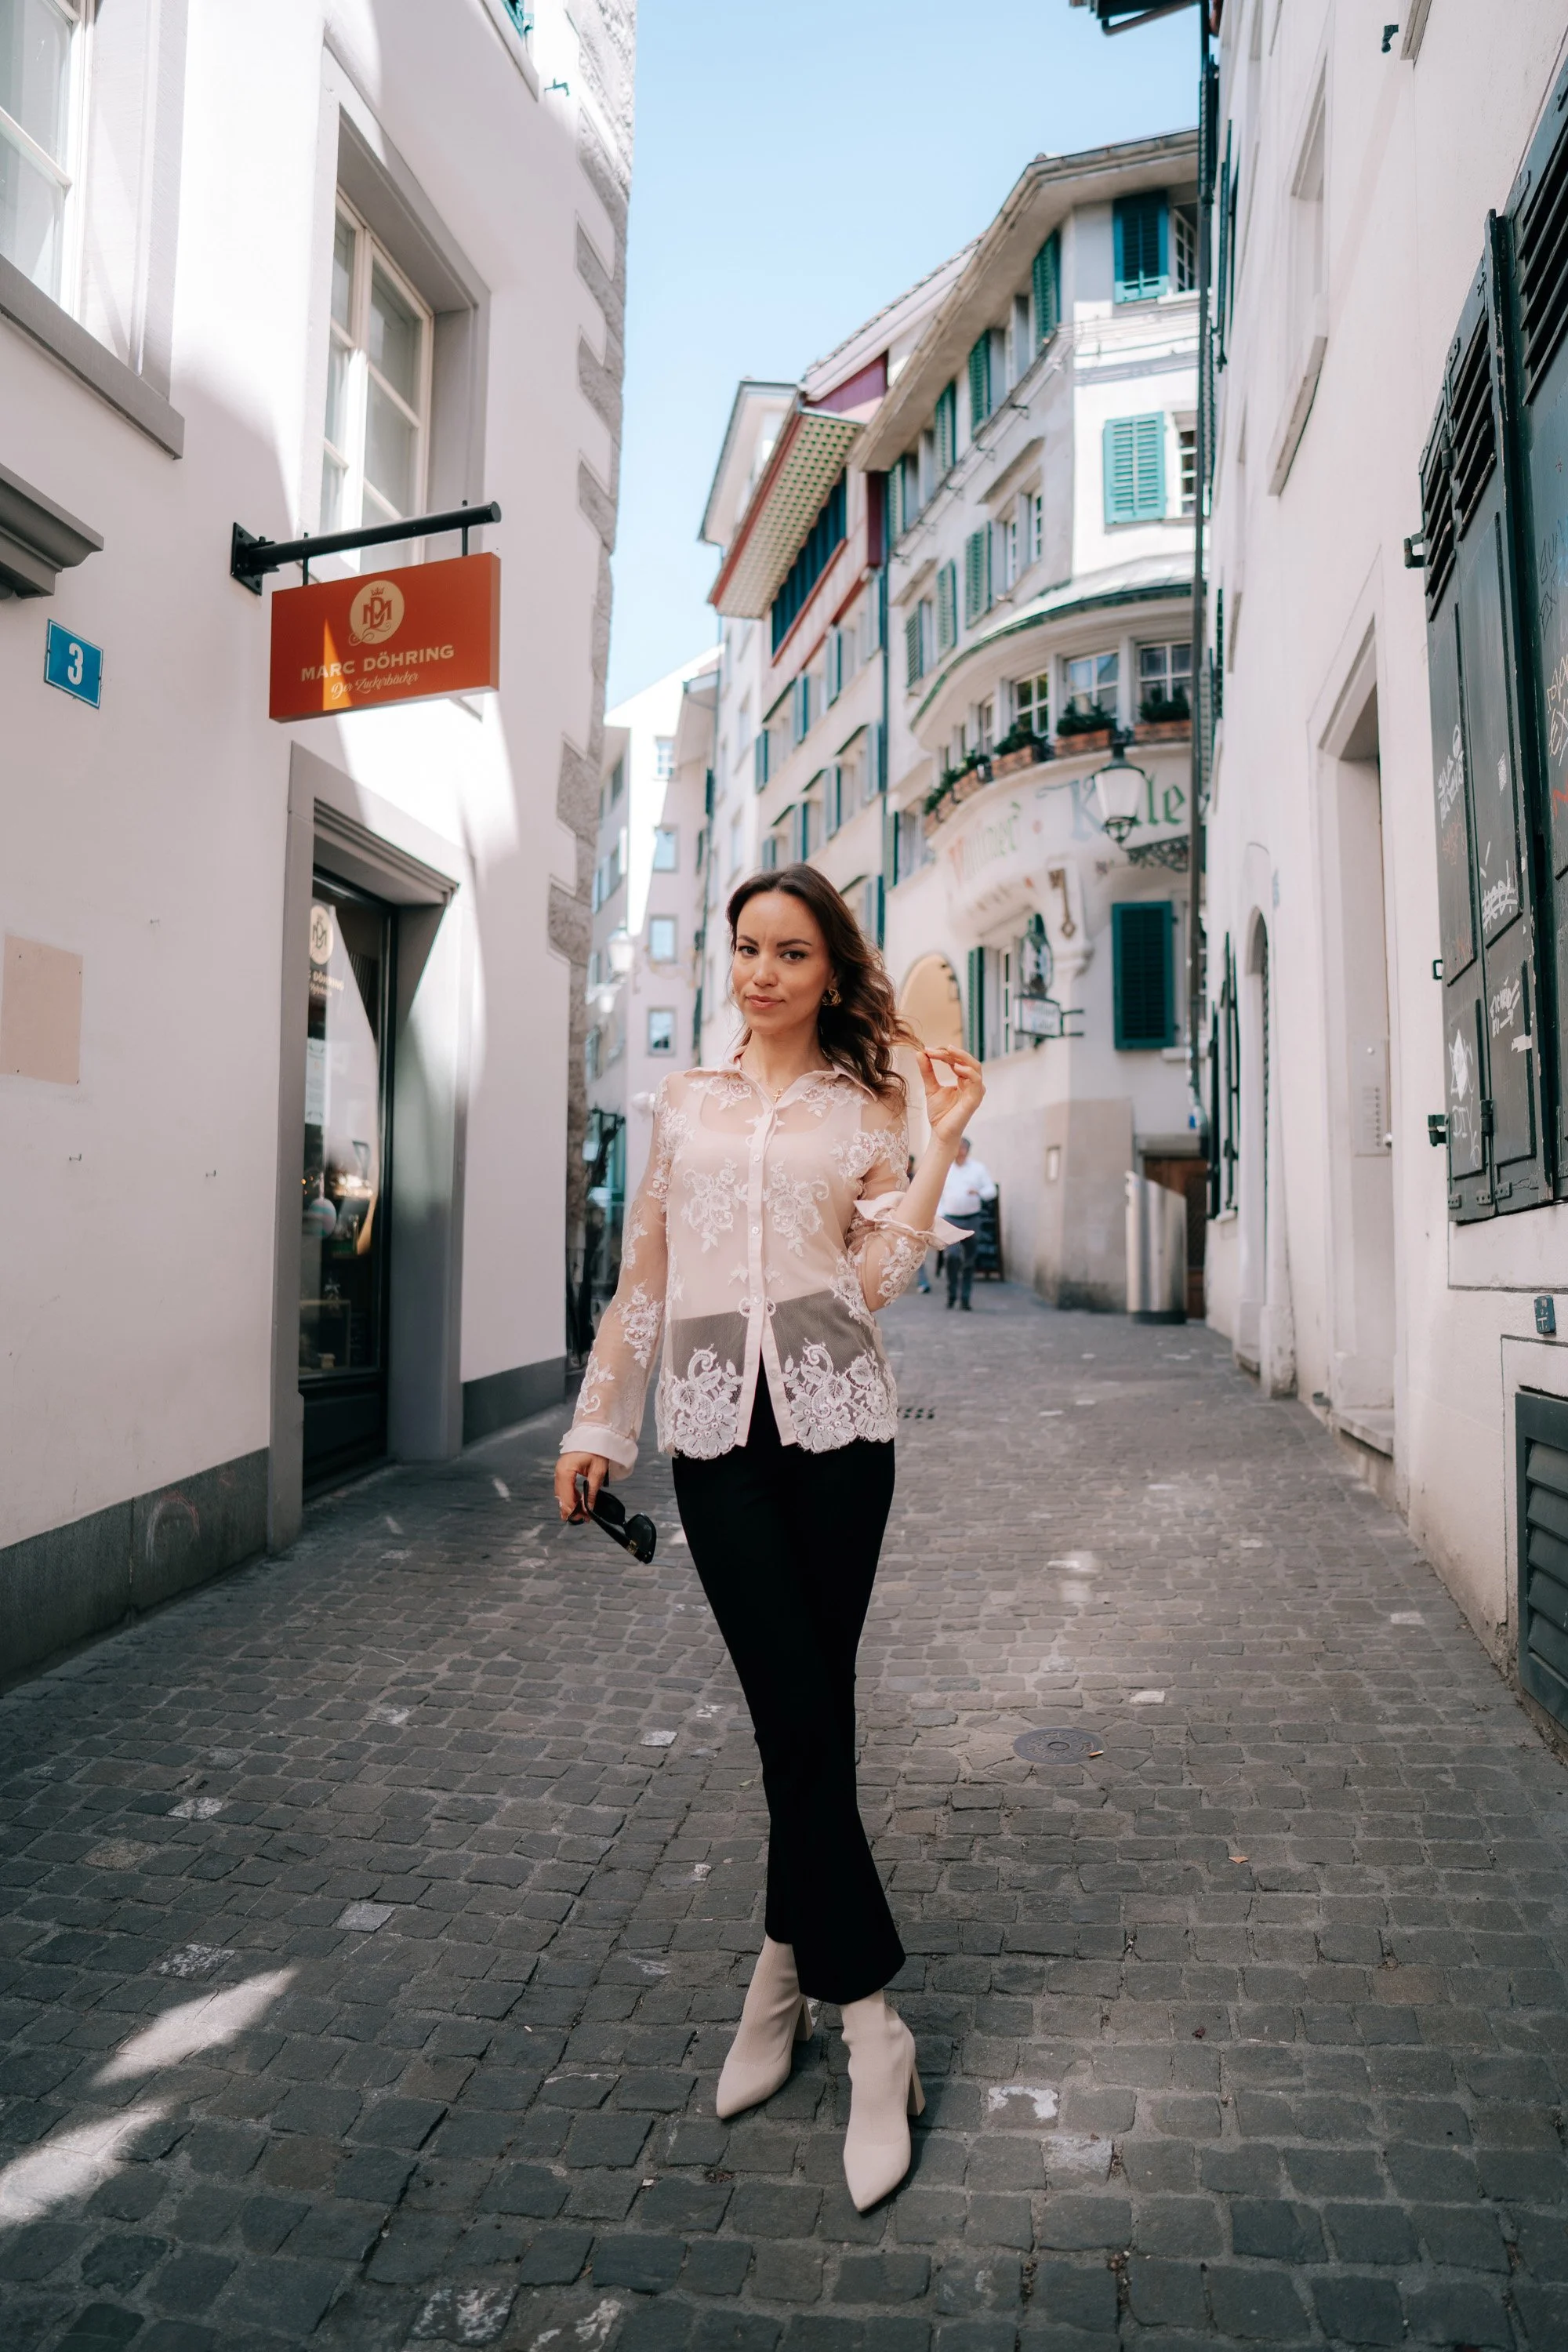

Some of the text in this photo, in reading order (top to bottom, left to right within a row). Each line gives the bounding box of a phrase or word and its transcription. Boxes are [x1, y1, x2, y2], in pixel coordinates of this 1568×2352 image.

[67, 642, 84, 685] 3
[301, 644, 455, 681] MARC DÖHRING
[331, 670, 419, 699] Der Zuckerbäcker
